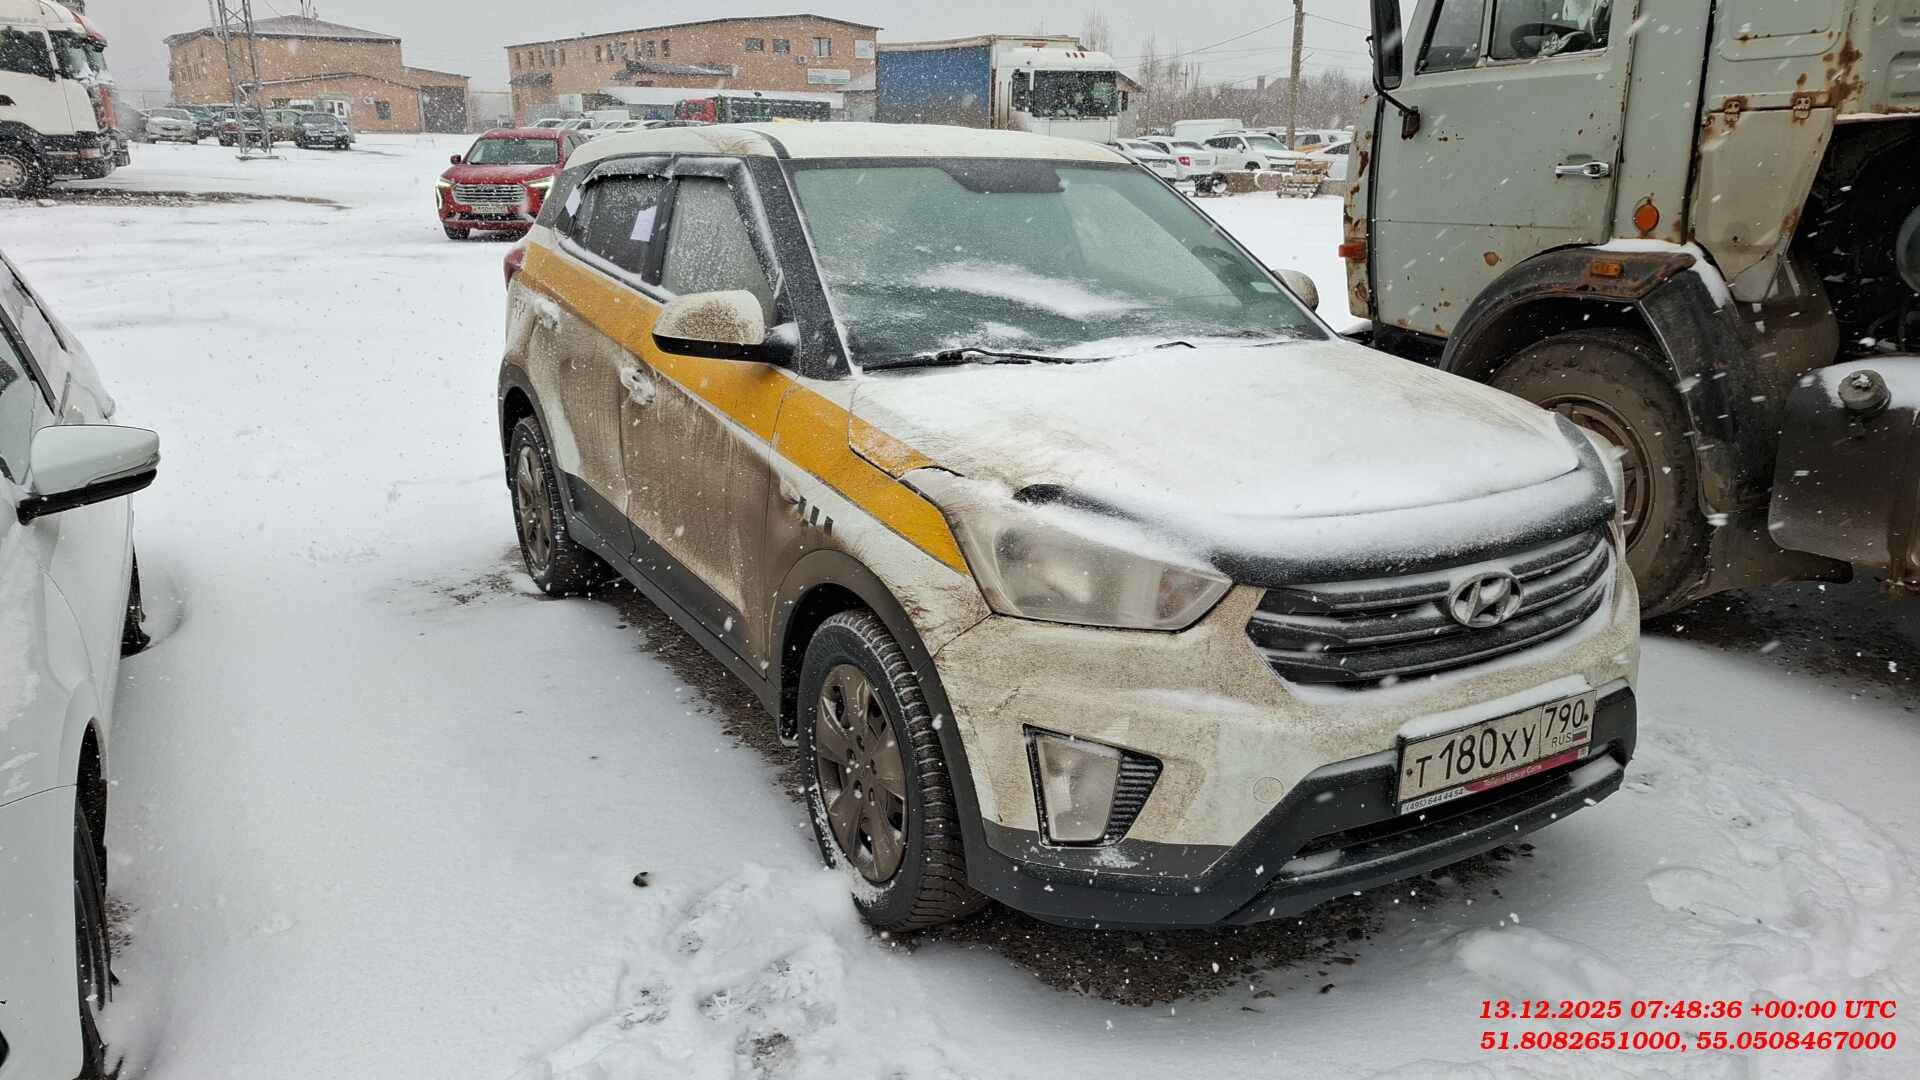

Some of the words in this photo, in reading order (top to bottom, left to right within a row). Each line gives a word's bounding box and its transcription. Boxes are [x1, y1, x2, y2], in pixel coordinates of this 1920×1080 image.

[1416, 723, 1536, 788] Т180ХУ
[1545, 699, 1586, 738] 790
[1552, 732, 1572, 748] RUS
[1406, 798, 1427, 813] (495)
[1428, 794, 1442, 806] 644
